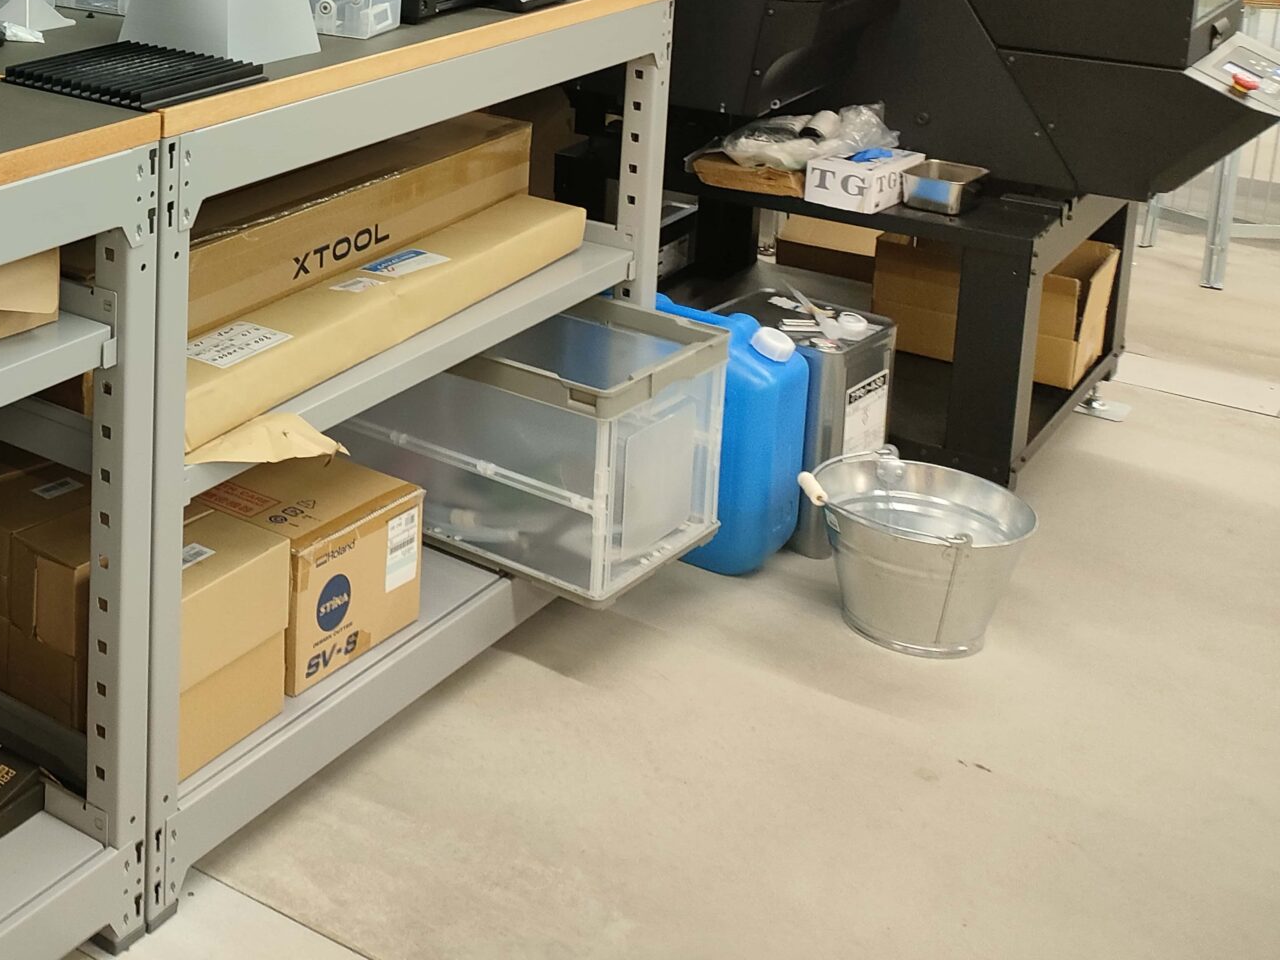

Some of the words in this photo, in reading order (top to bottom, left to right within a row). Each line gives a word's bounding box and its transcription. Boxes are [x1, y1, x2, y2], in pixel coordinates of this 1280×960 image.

[810, 167, 868, 197] TG
[293, 224, 390, 280] XTOOL
[327, 538, 356, 562] Roland
